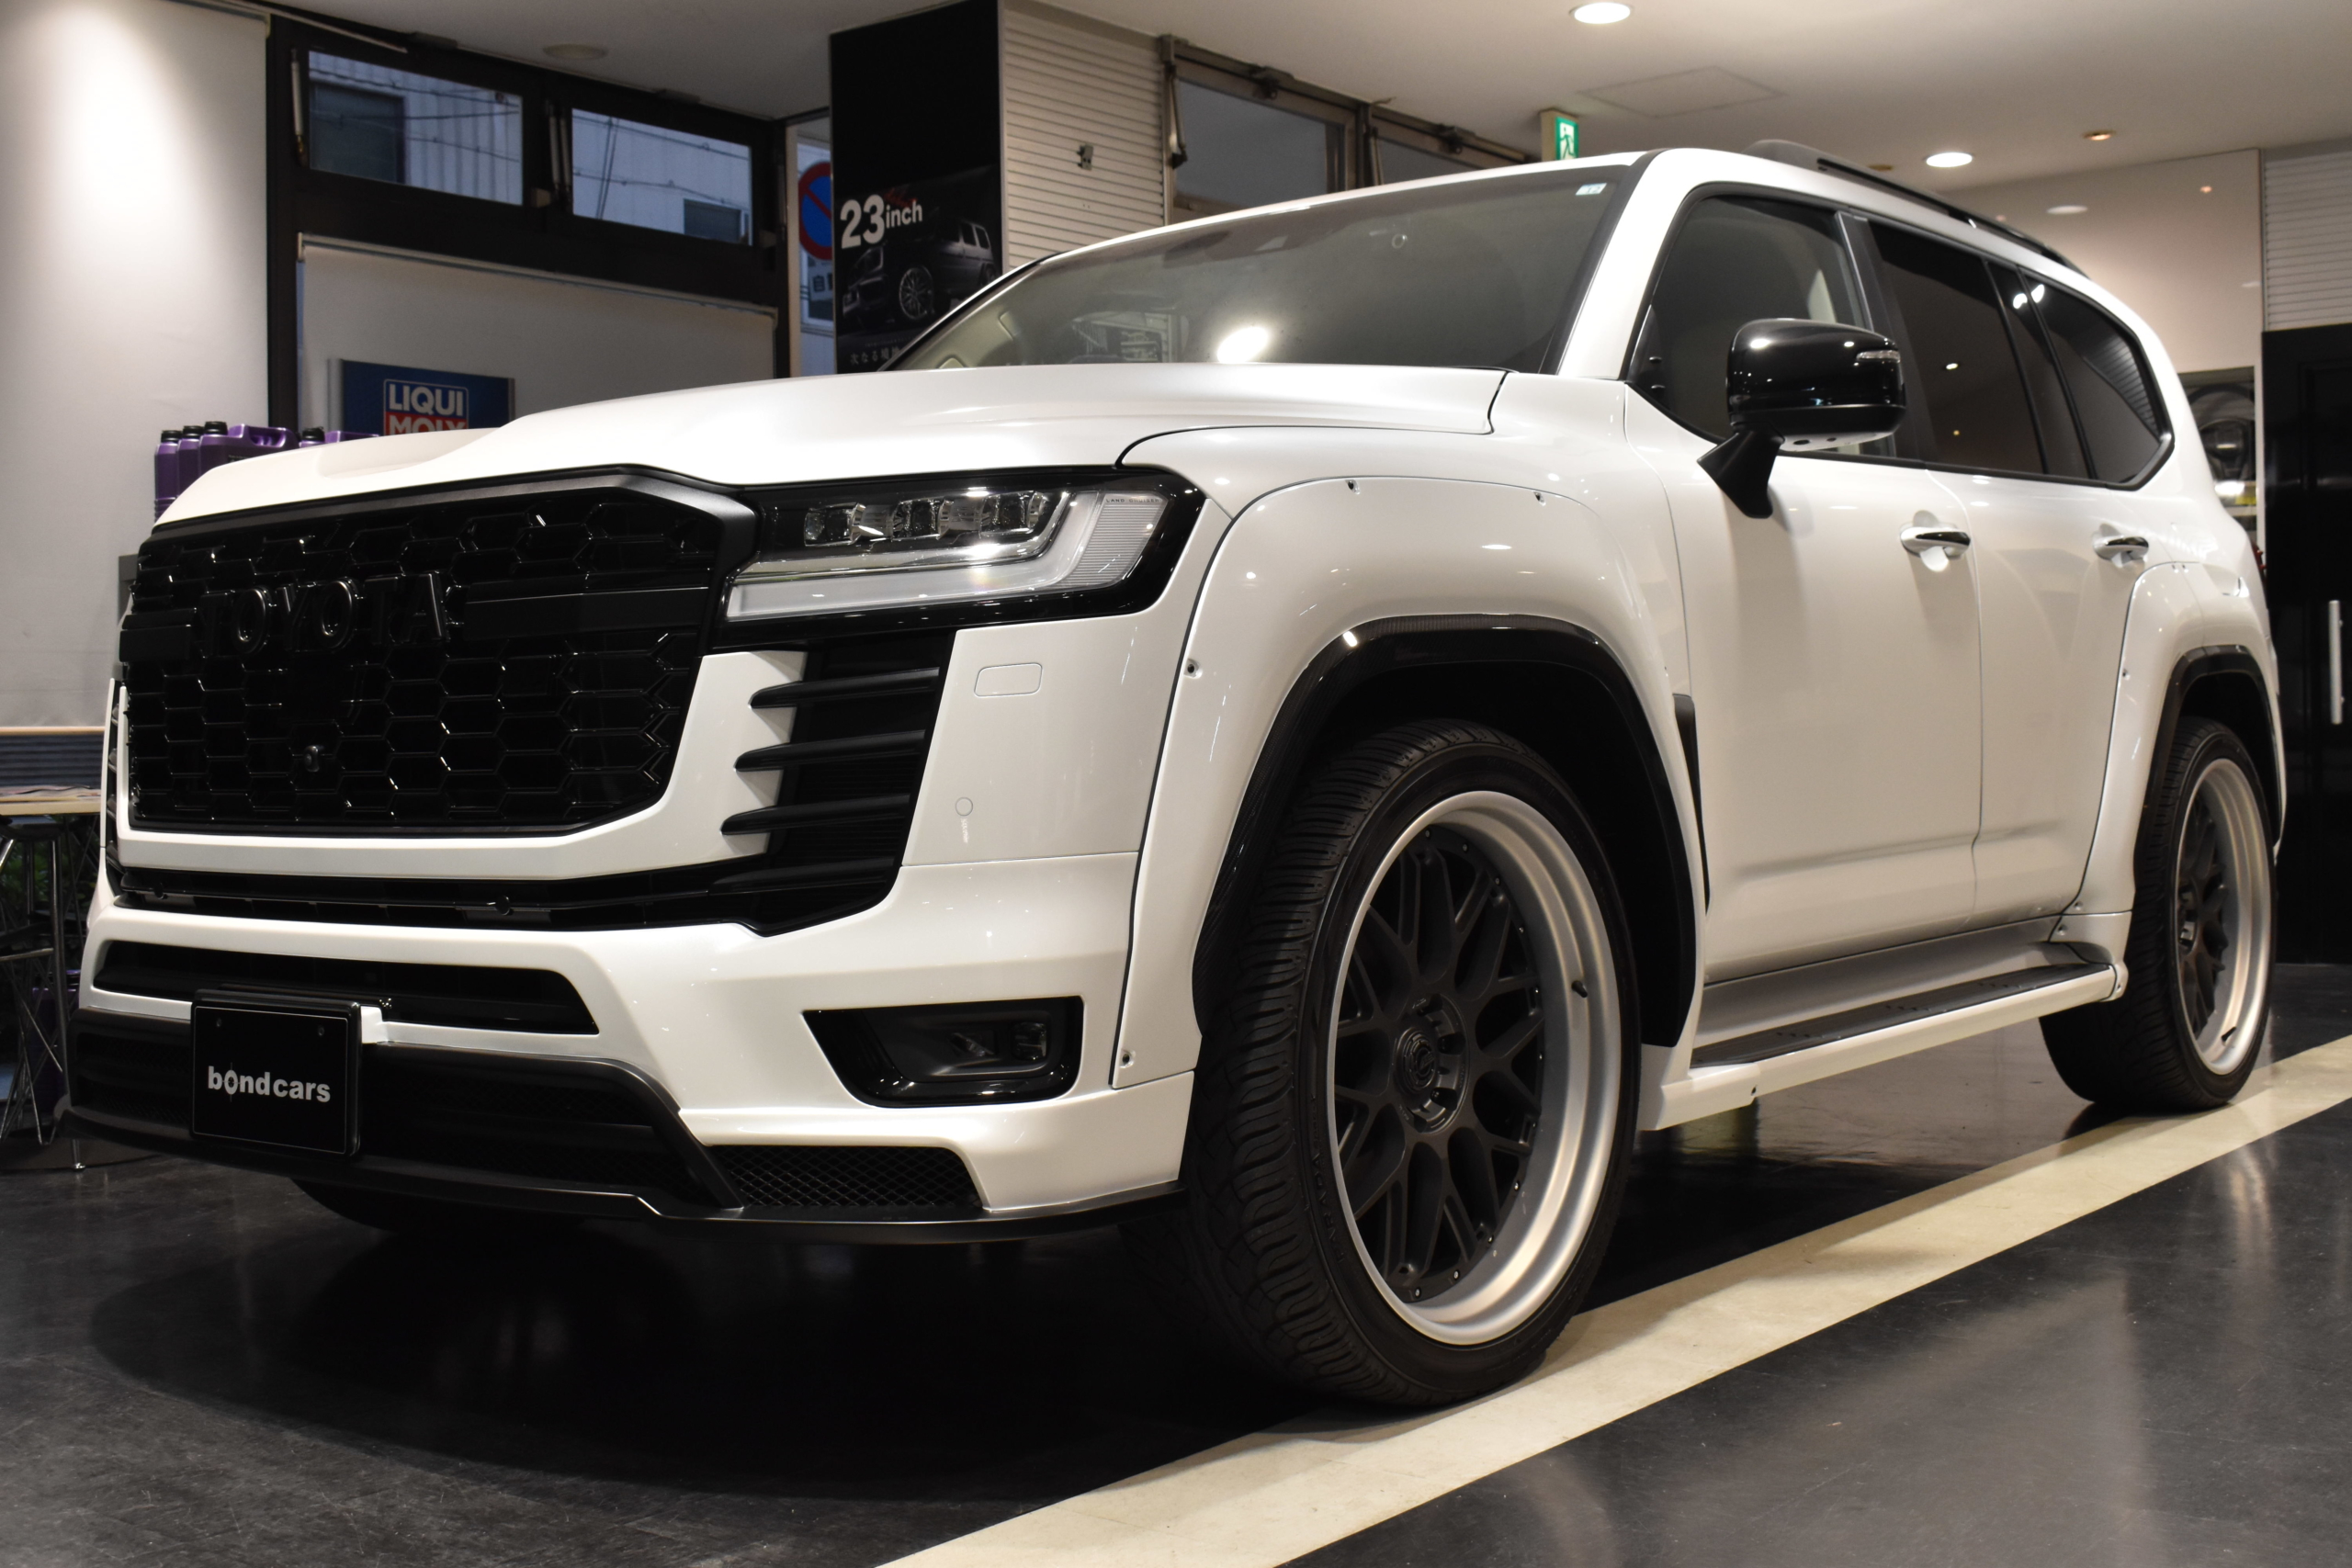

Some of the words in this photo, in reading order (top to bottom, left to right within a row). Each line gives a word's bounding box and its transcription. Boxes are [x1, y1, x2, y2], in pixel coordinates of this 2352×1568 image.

[389, 384, 464, 416] LIQUI
[199, 570, 450, 657] TOYOTA
[1312, 1153, 1345, 1263] PARADA
